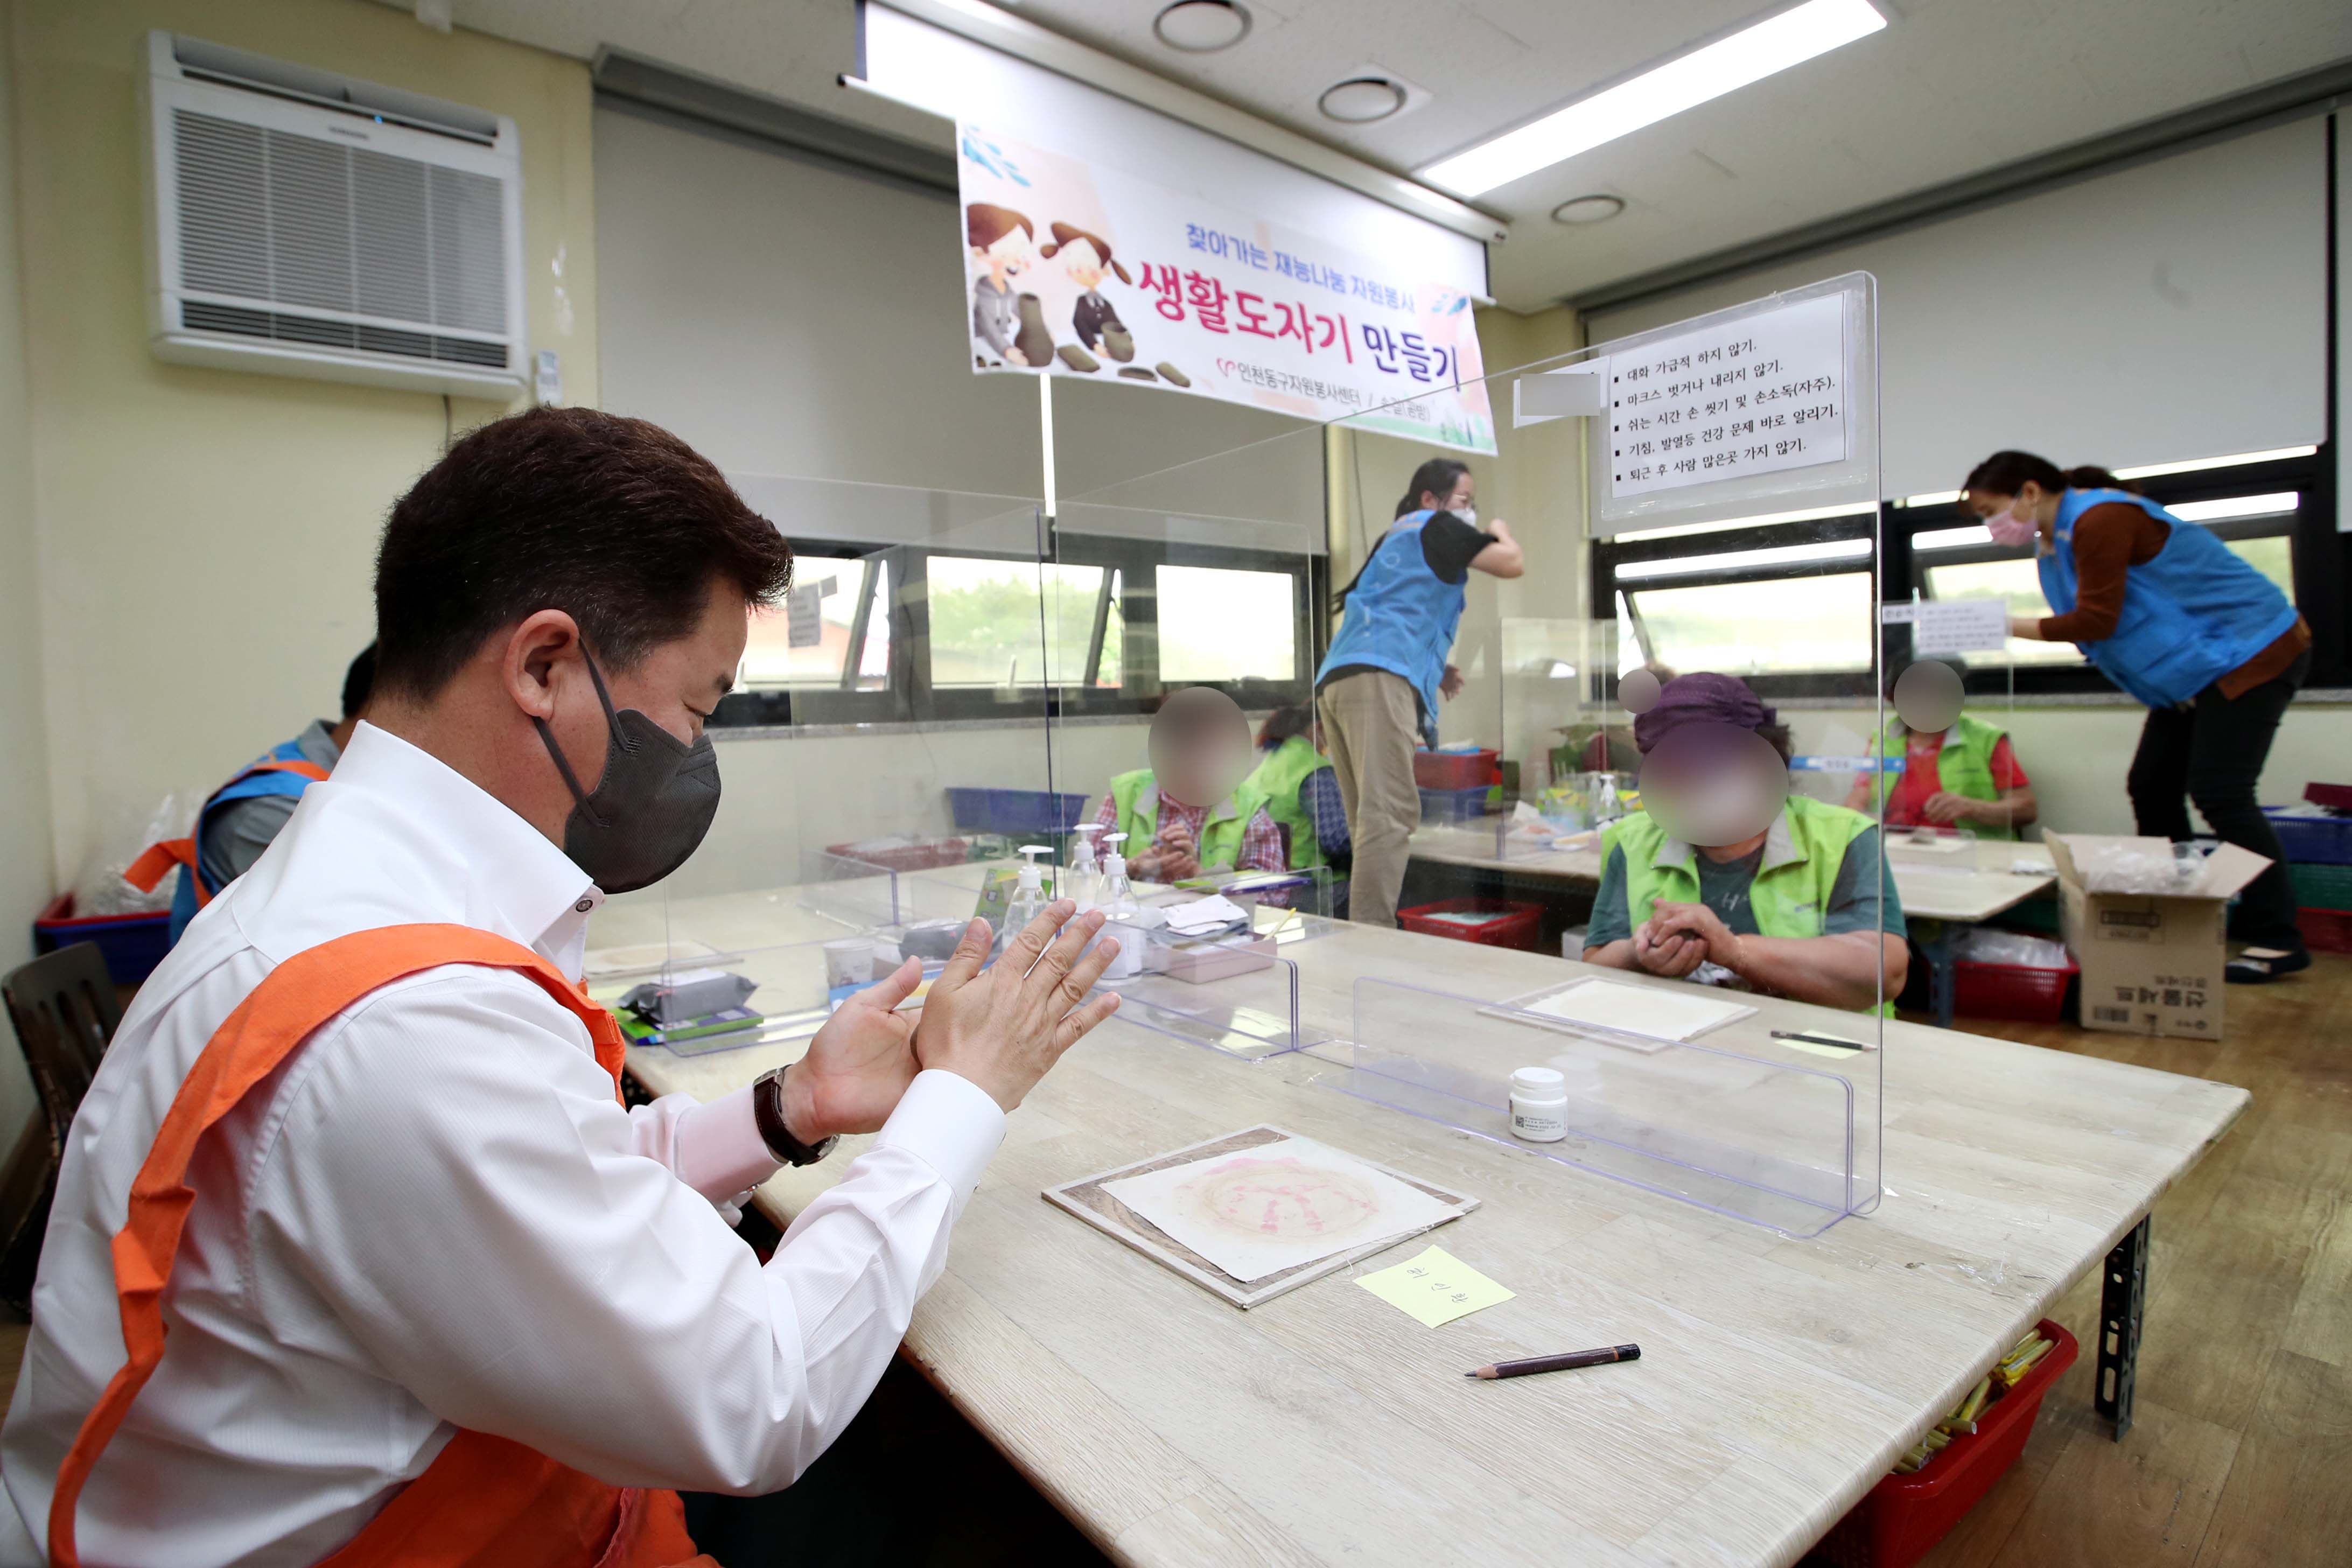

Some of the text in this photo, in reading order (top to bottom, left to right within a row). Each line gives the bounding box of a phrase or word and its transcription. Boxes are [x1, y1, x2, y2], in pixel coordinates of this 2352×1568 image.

[1186, 223, 1416, 314] 찾아가는 재능나눔 자원봉사
[1139, 261, 1460, 391] 생활도자기 만들기
[1628, 339, 1756, 381] 대화 가급적 하지 않기.
[1628, 359, 1783, 405] 마크스 벗거나 내리지 않기.
[1238, 362, 1361, 407] 인천동구자원봉사센터
[1628, 375, 1836, 431] 쉬는 시간 손 씻기 및 손소독(자주).
[1661, 433, 1695, 451] 발열등
[1702, 426, 1724, 443] 건강
[1730, 419, 1754, 437] 문제
[1761, 414, 1786, 430] 바로
[1793, 403, 1838, 424] 알리기.
[1630, 438, 1807, 481] 퇴근 후 사람 많은곳 가지 않기.
